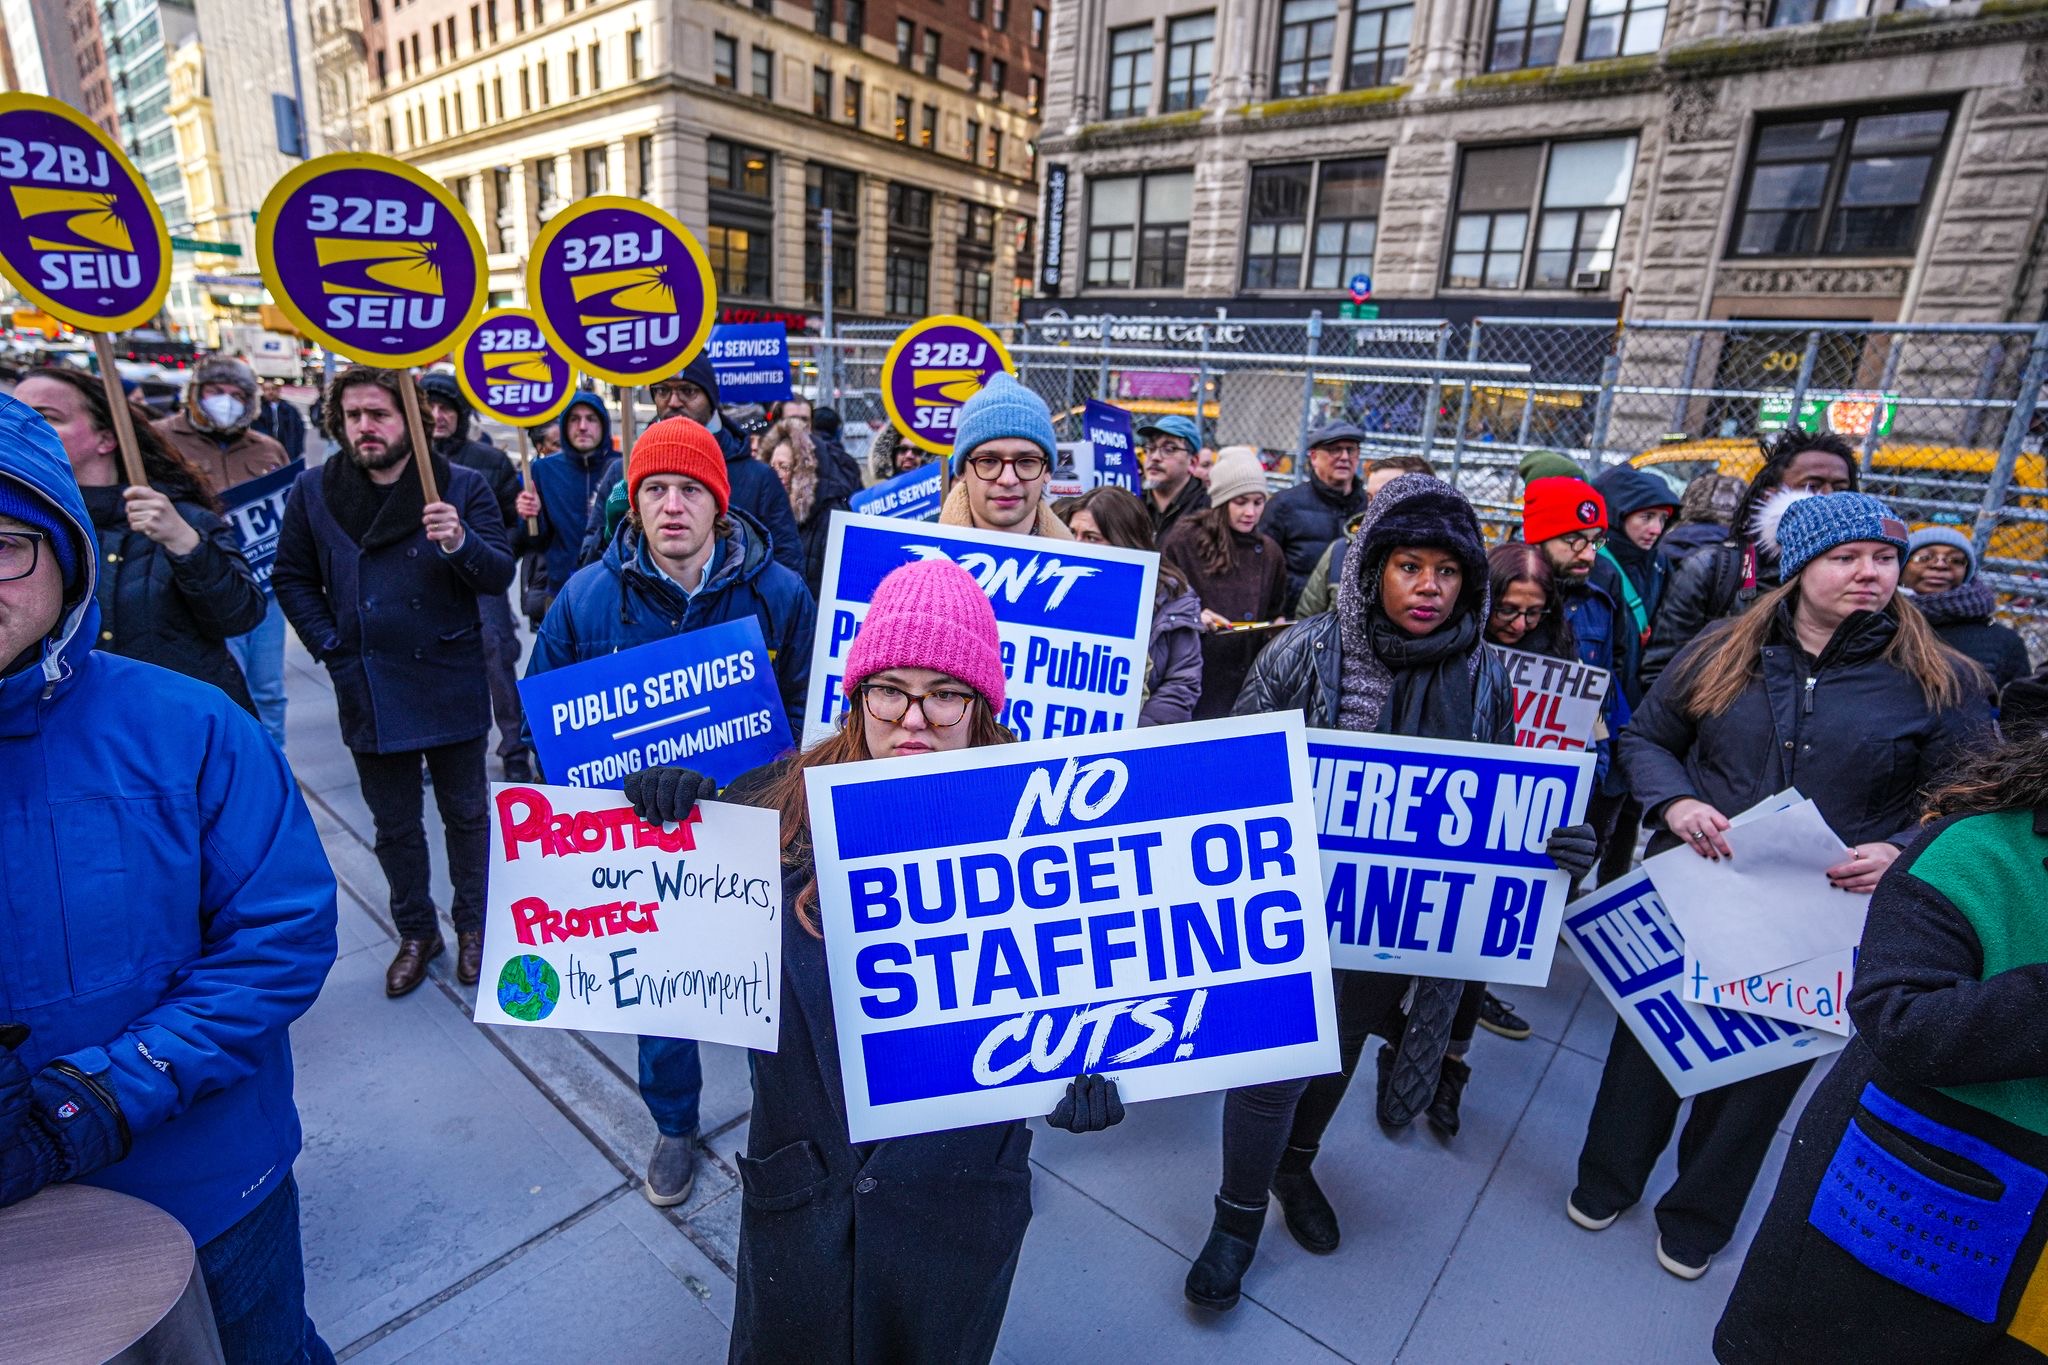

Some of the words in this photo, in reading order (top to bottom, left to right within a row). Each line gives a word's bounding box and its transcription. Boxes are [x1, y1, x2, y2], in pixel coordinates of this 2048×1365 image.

[0, 137, 110, 187] 32BJ
[306, 194, 436, 236] 32BJ
[40, 253, 141, 290] SEIU
[562, 229, 663, 272] 32BJ
[326, 296, 446, 329] SEIU
[585, 315, 680, 356] SEIU
[478, 328, 546, 352] 32BJ
[724, 338, 780, 358] SERVICES
[910, 342, 987, 367] 32BJ
[488, 383, 554, 406] SEIU
[722, 370, 784, 386] COMMUNITIES
[913, 407, 962, 429] SEI
[1090, 427, 1128, 450] HONOR
[1104, 452, 1122, 466] THE
[860, 492, 898, 515] PUBLIC
[898, 475, 942, 505] SERVICE
[901, 545, 1103, 613] ON'T
[1024, 636, 1131, 697] Public
[1541, 659, 1607, 702] THE
[552, 683, 639, 736] PUBLIC
[643, 650, 755, 708] SERVICES
[1512, 688, 1566, 733] VIL
[568, 748, 641, 788] STRONG
[646, 709, 772, 767] COMMUNITIES
[1008, 756, 1129, 839] NO
[1309, 757, 1479, 848] HERE'S
[1485, 773, 1567, 854] NO
[495, 787, 703, 862] PROTECT
[592, 866, 643, 890] our
[652, 860, 775, 921] Workers,
[848, 832, 1162, 933] BUDGET
[1191, 817, 1296, 886] OR
[510, 897, 660, 946] PROTECT
[1325, 862, 1476, 953] ANET
[1480, 876, 1548, 960] B!
[855, 890, 1305, 1020] STAFFING
[566, 954, 602, 1005] the
[608, 948, 772, 1024] Environment!
[972, 989, 1209, 1086] CUTS!
[1855, 1156, 1911, 1201] METRO
[1922, 1203, 1980, 1232] CARD
[1839, 1206, 1875, 1239] NEW
[1888, 1241, 1941, 1275] YORK
